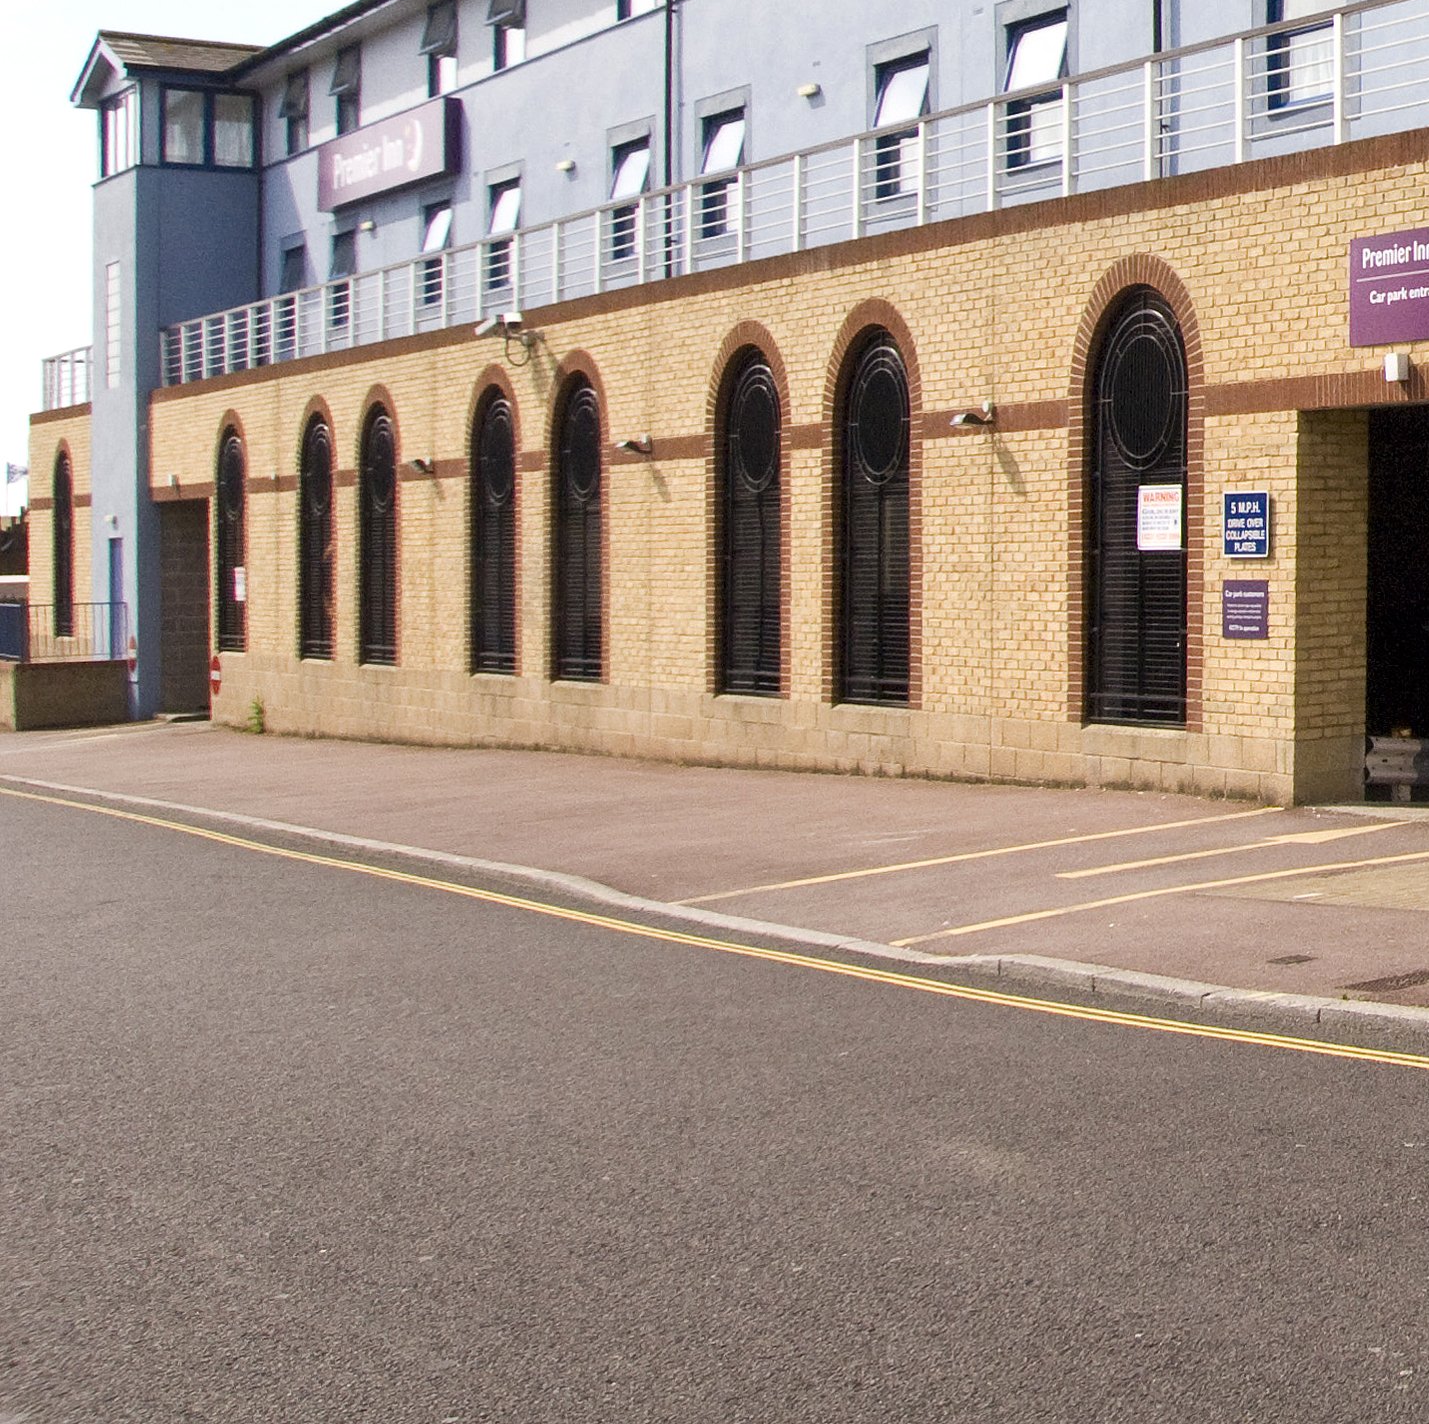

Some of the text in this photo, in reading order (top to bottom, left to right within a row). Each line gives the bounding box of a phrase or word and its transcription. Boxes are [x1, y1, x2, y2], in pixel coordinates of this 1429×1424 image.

[333, 134, 404, 190] Premier Inn
[1362, 243, 1412, 269] Premier
[1369, 290, 1386, 304] Car
[1387, 287, 1407, 305] park
[1142, 491, 1180, 503] WARNING
[1230, 501, 1237, 514] 5
[1227, 517, 1264, 528] DRIVE OVER
[1225, 529, 1266, 541] COLLAPSIBLE
[1234, 541, 1257, 552] PLATES
